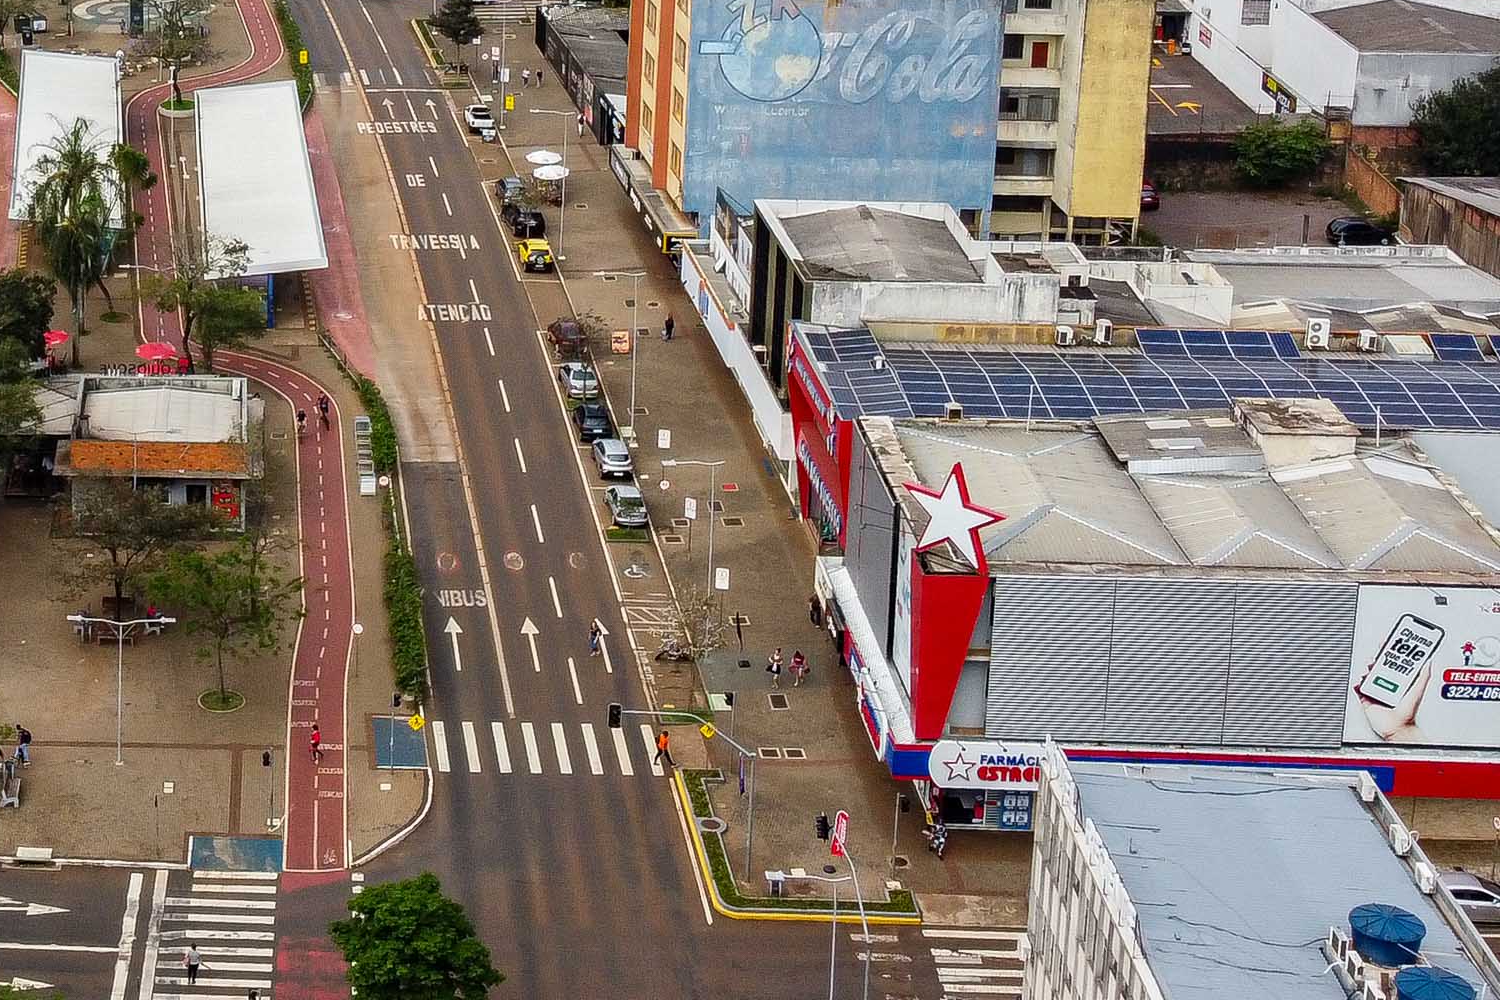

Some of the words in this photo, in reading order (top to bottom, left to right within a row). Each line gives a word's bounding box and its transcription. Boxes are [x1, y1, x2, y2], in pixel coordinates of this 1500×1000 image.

[357, 121, 437, 134] PEDESTRES
[406, 174, 426, 187] DE
[389, 234, 480, 250] TRAVESSIA
[1400, 628, 1433, 647] Chama
[1384, 651, 1400, 662] que
[1390, 638, 1426, 662] tele
[1383, 657, 1415, 676] vem!
[980, 754, 1046, 766] FARMÁCI
